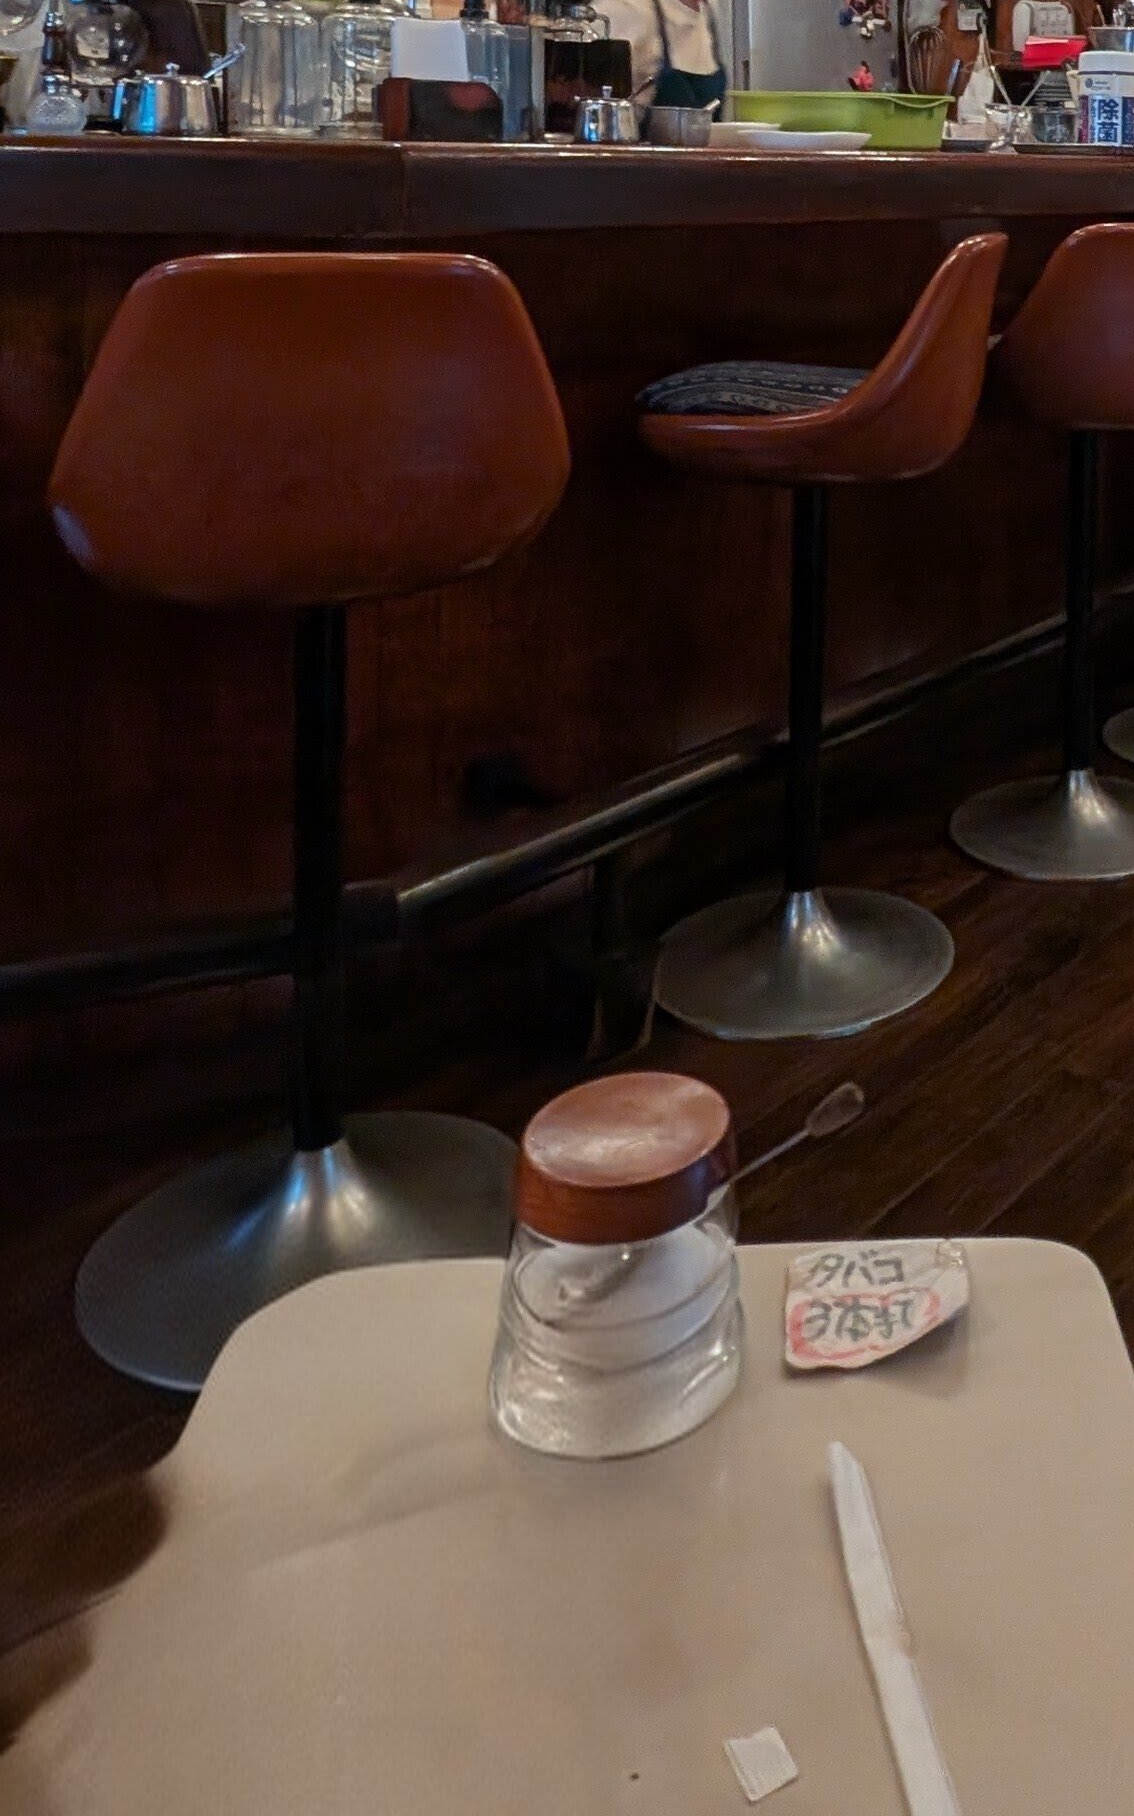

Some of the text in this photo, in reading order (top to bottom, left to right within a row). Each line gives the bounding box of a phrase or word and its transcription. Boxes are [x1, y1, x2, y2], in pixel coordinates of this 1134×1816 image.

[1098, 98, 1119, 142] 除菌
[808, 1248, 904, 1288] タバコ
